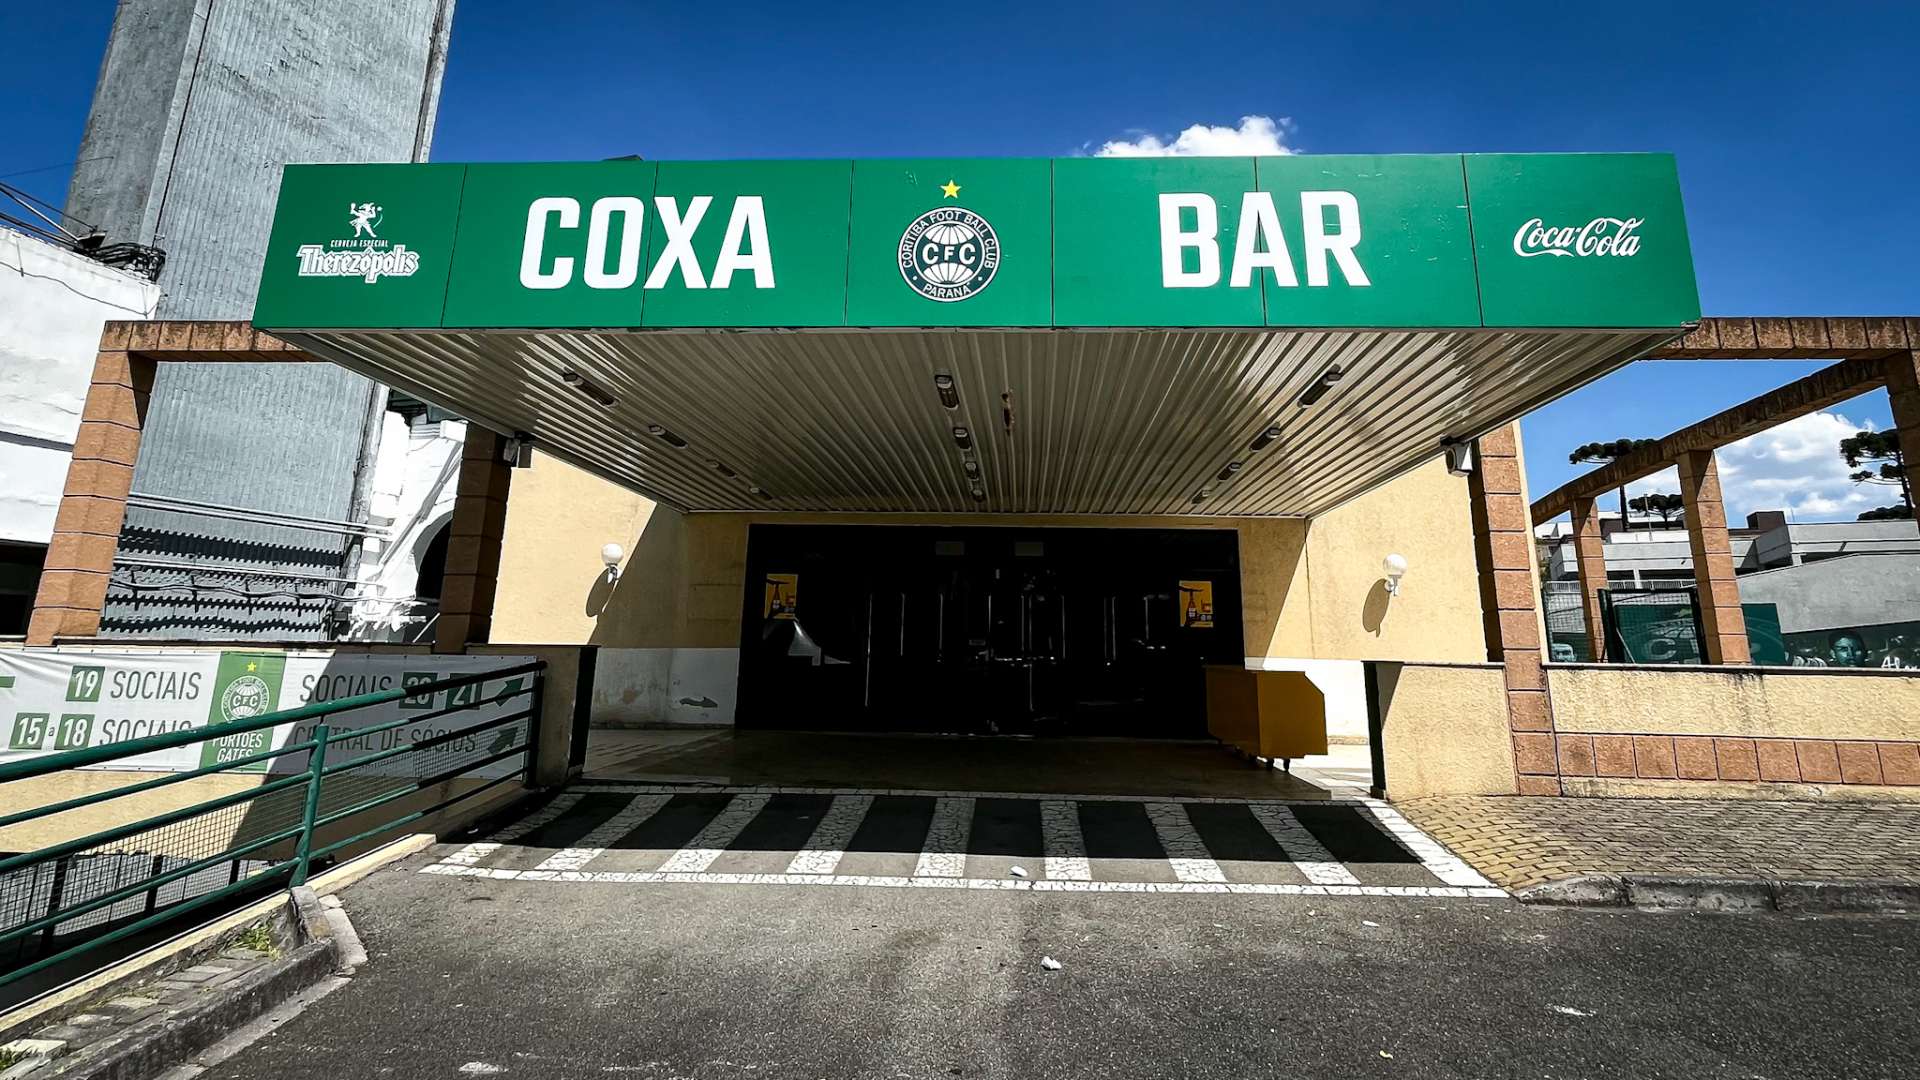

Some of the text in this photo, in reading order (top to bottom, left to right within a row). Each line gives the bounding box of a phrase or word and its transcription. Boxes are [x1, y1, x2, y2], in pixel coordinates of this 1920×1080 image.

[520, 190, 1372, 290] COXA BAR
[901, 210, 997, 269] CORITIBA FOOT BALL CLUB
[922, 242, 976, 265] CFC
[1513, 217, 1645, 257] Coca-Cola
[296, 244, 420, 284] Therezópolis
[73, 669, 99, 698] 19
[110, 670, 202, 700] SOCIAIS
[233, 695, 258, 707] CFC
[17, 717, 43, 745] 15
[63, 718, 88, 746] 18
